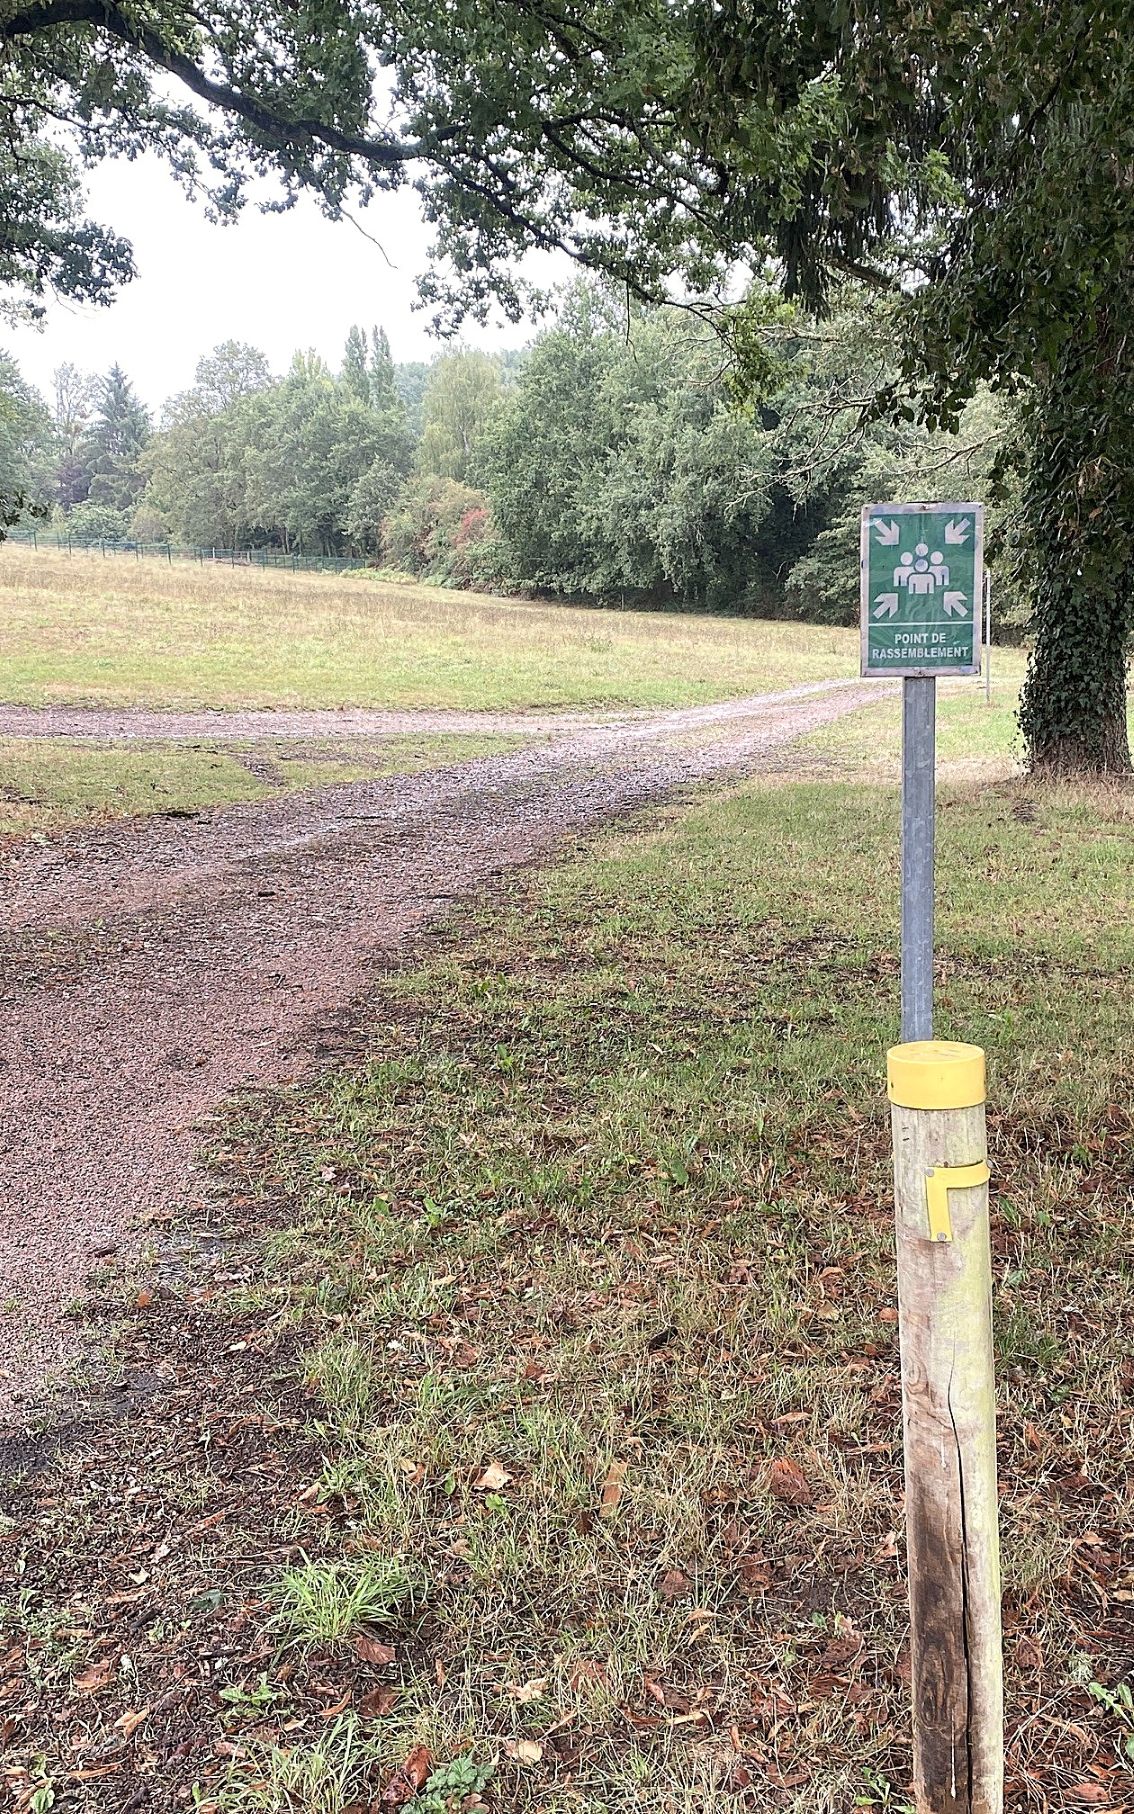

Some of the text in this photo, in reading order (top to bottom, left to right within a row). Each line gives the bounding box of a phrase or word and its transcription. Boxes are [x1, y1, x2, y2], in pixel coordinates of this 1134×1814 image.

[894, 632, 947, 644] POINT DE
[872, 646, 969, 659] RASSEMBLEMENT
